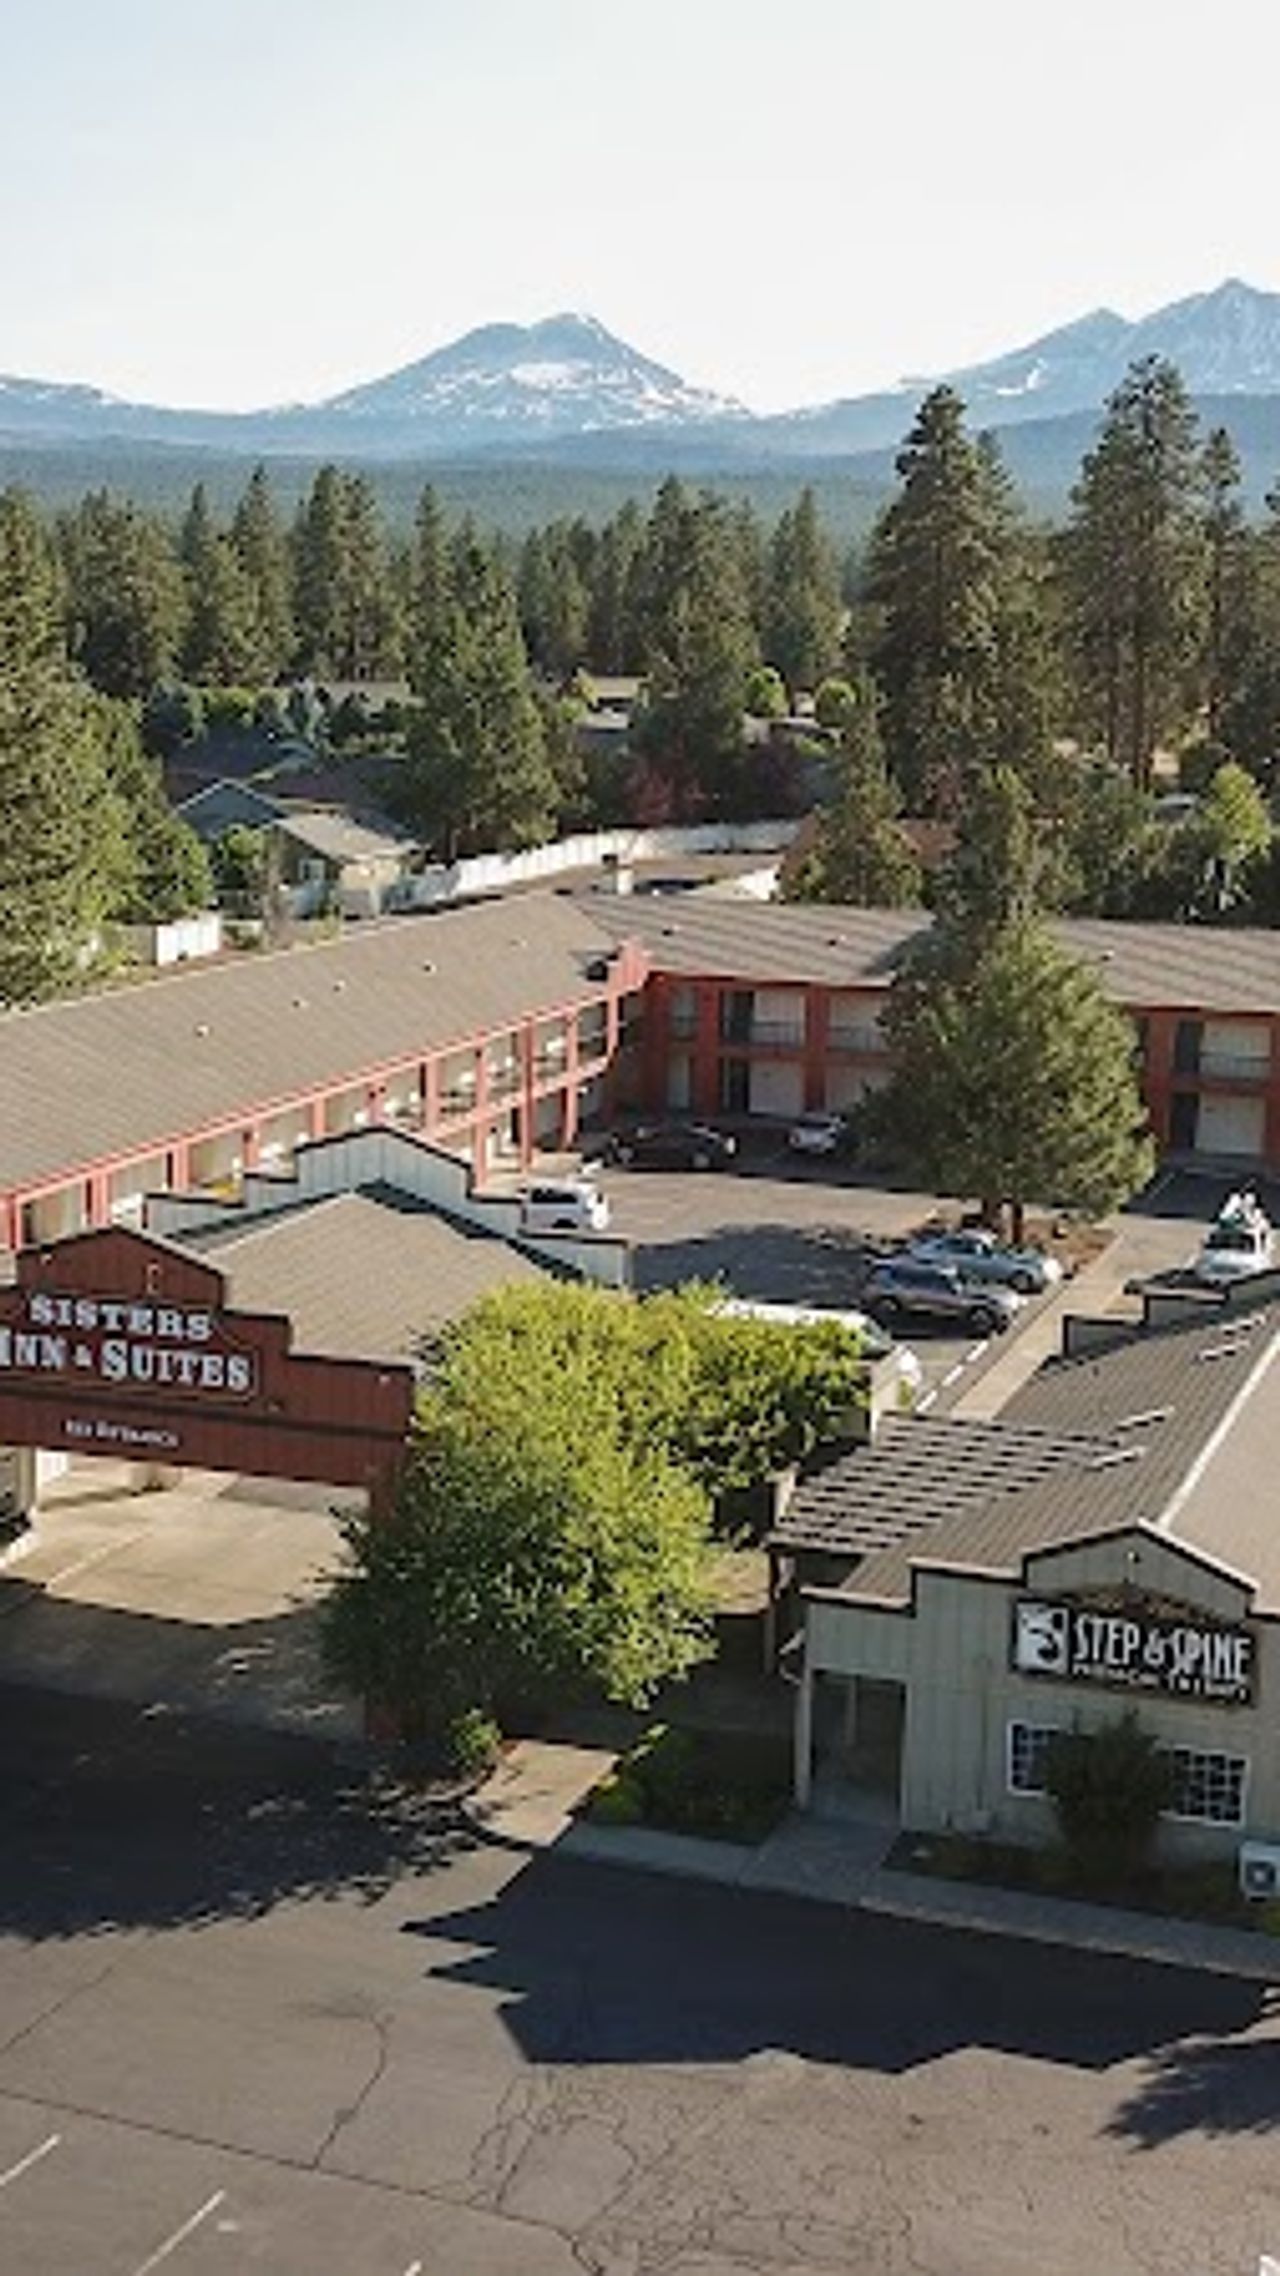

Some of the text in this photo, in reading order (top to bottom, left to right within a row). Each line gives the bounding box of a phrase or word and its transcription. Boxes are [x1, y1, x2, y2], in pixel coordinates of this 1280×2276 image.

[30, 1296, 211, 1341] SISTERS
[0, 1327, 249, 1391] INN & SUITES
[1072, 1613, 1250, 1681] STEP & SPINE
